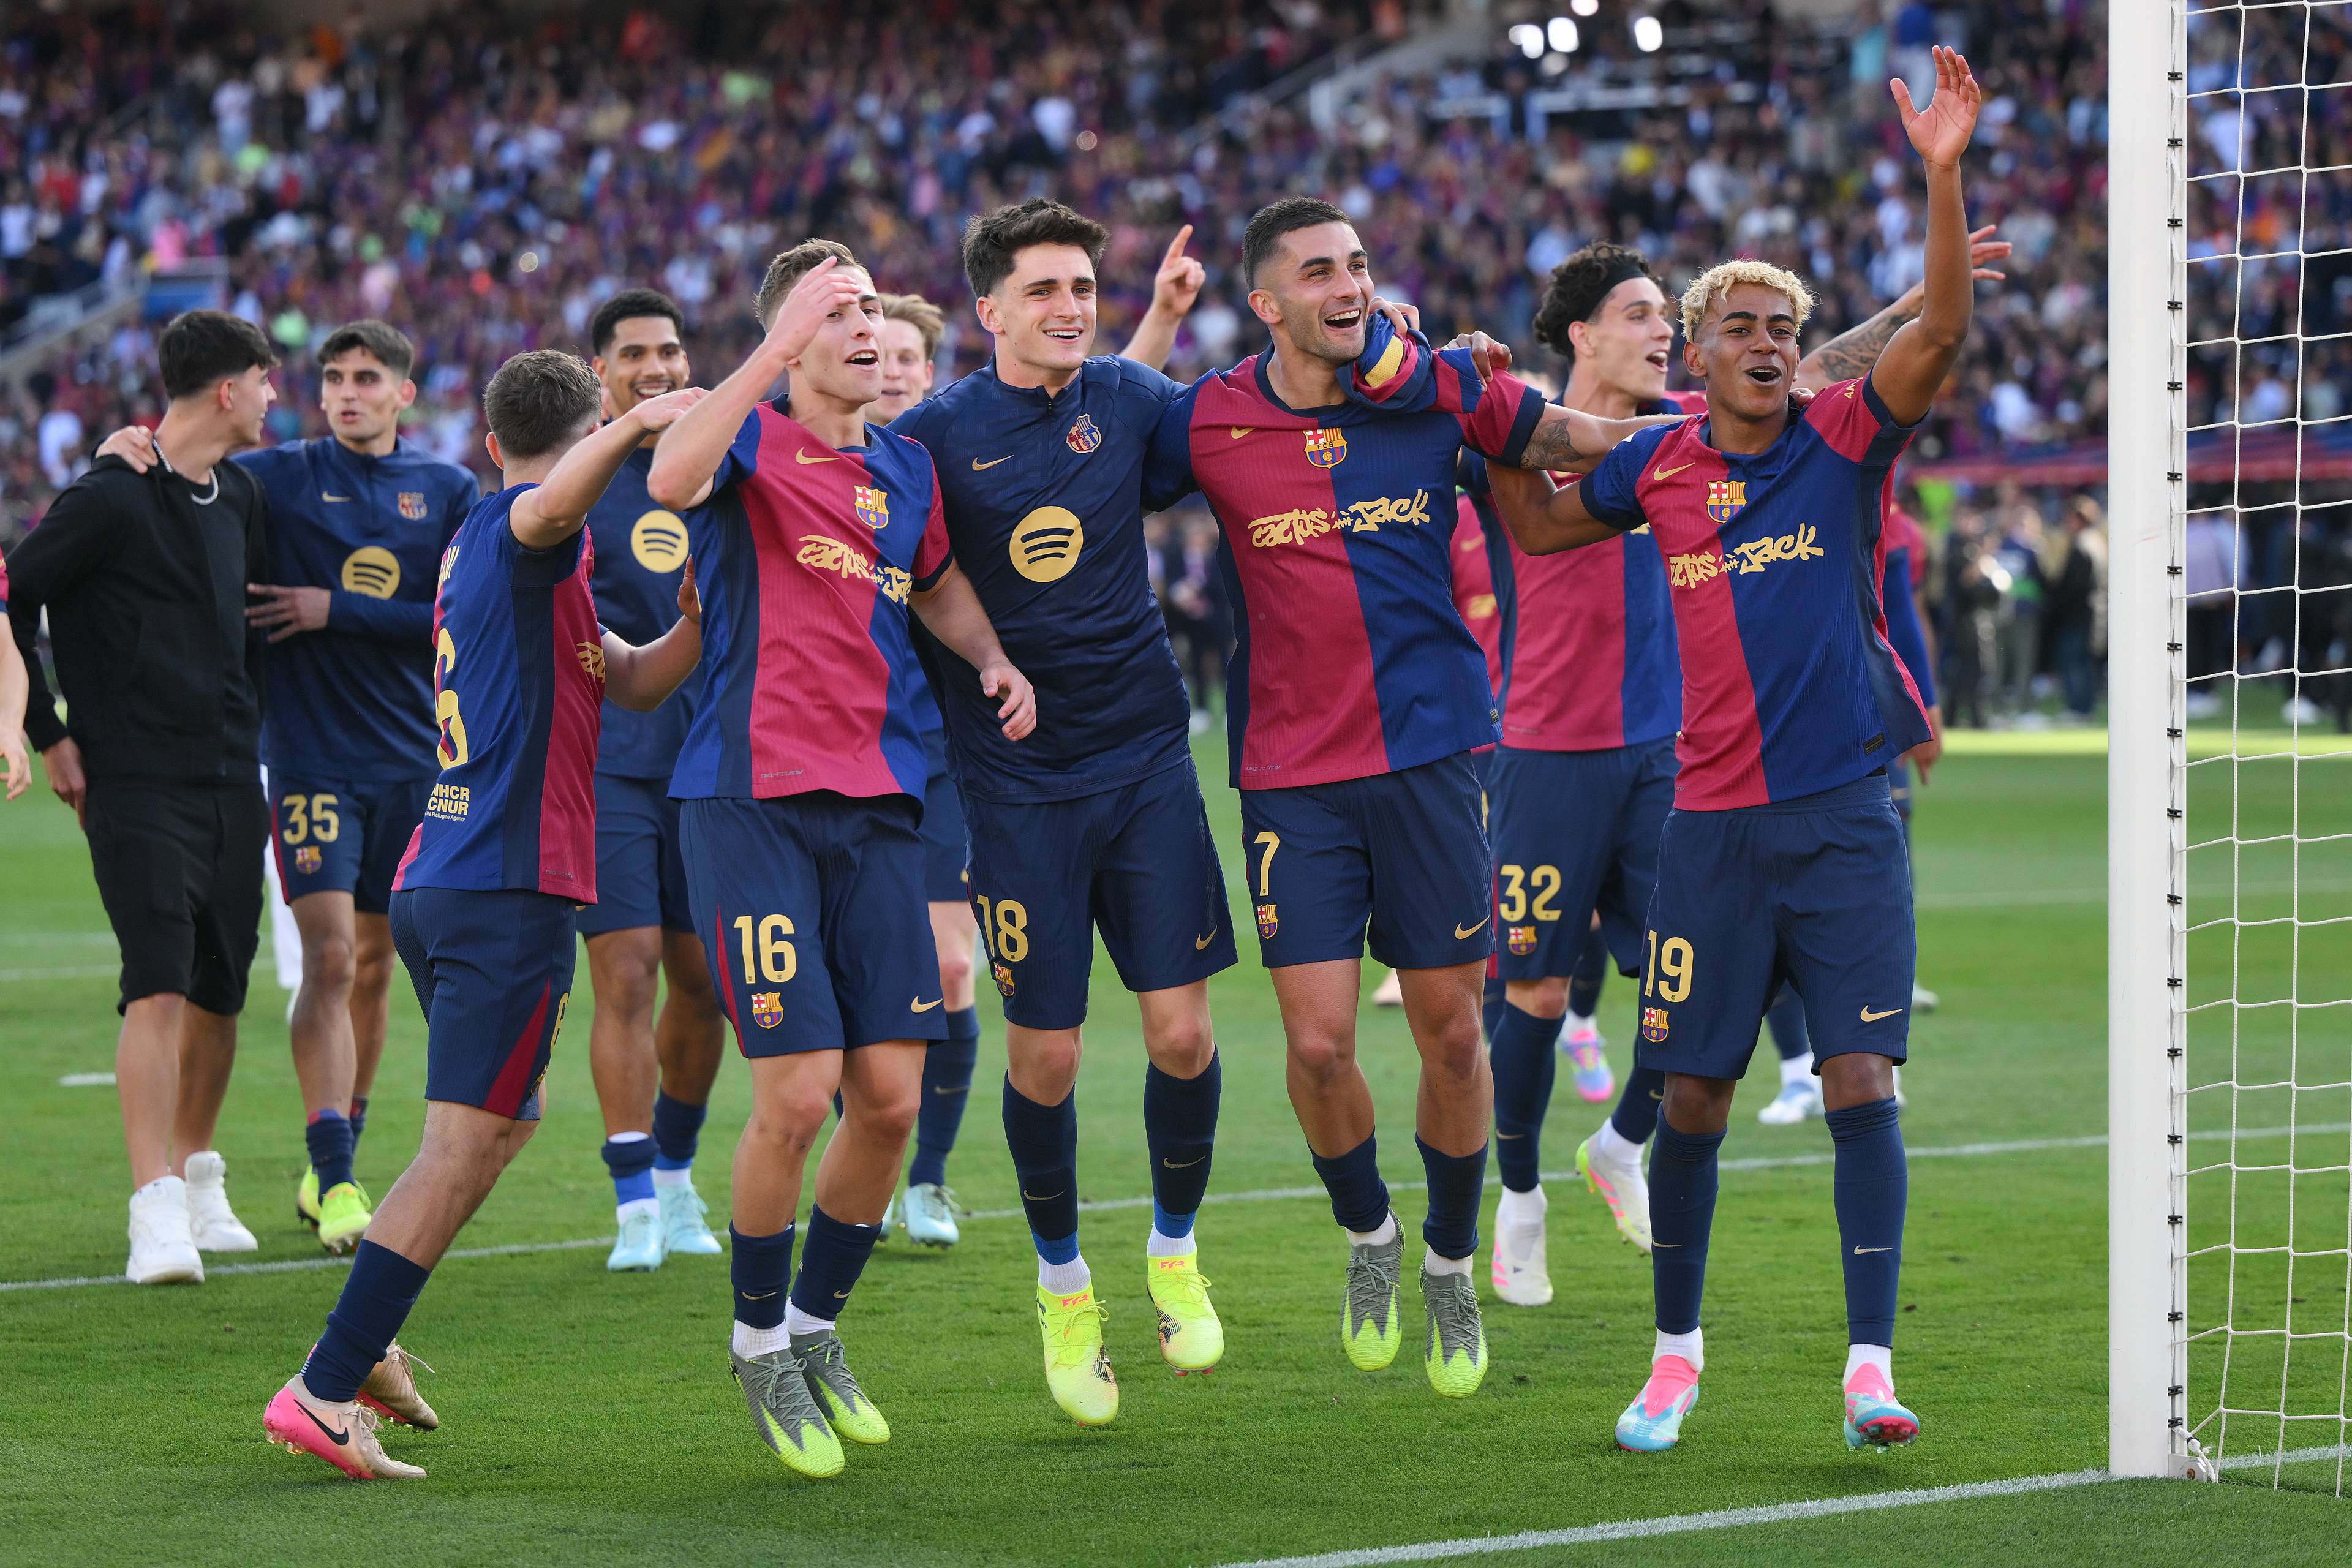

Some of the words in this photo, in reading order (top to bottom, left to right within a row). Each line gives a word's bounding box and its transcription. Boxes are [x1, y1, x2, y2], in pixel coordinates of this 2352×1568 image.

[282, 793, 340, 845] 35
[431, 811, 451, 820] Refugee
[1254, 831, 1280, 897] 7
[1499, 864, 1562, 922] 32
[733, 913, 797, 984] 16
[976, 894, 1029, 962] 18
[1644, 929, 1694, 1003] 19
